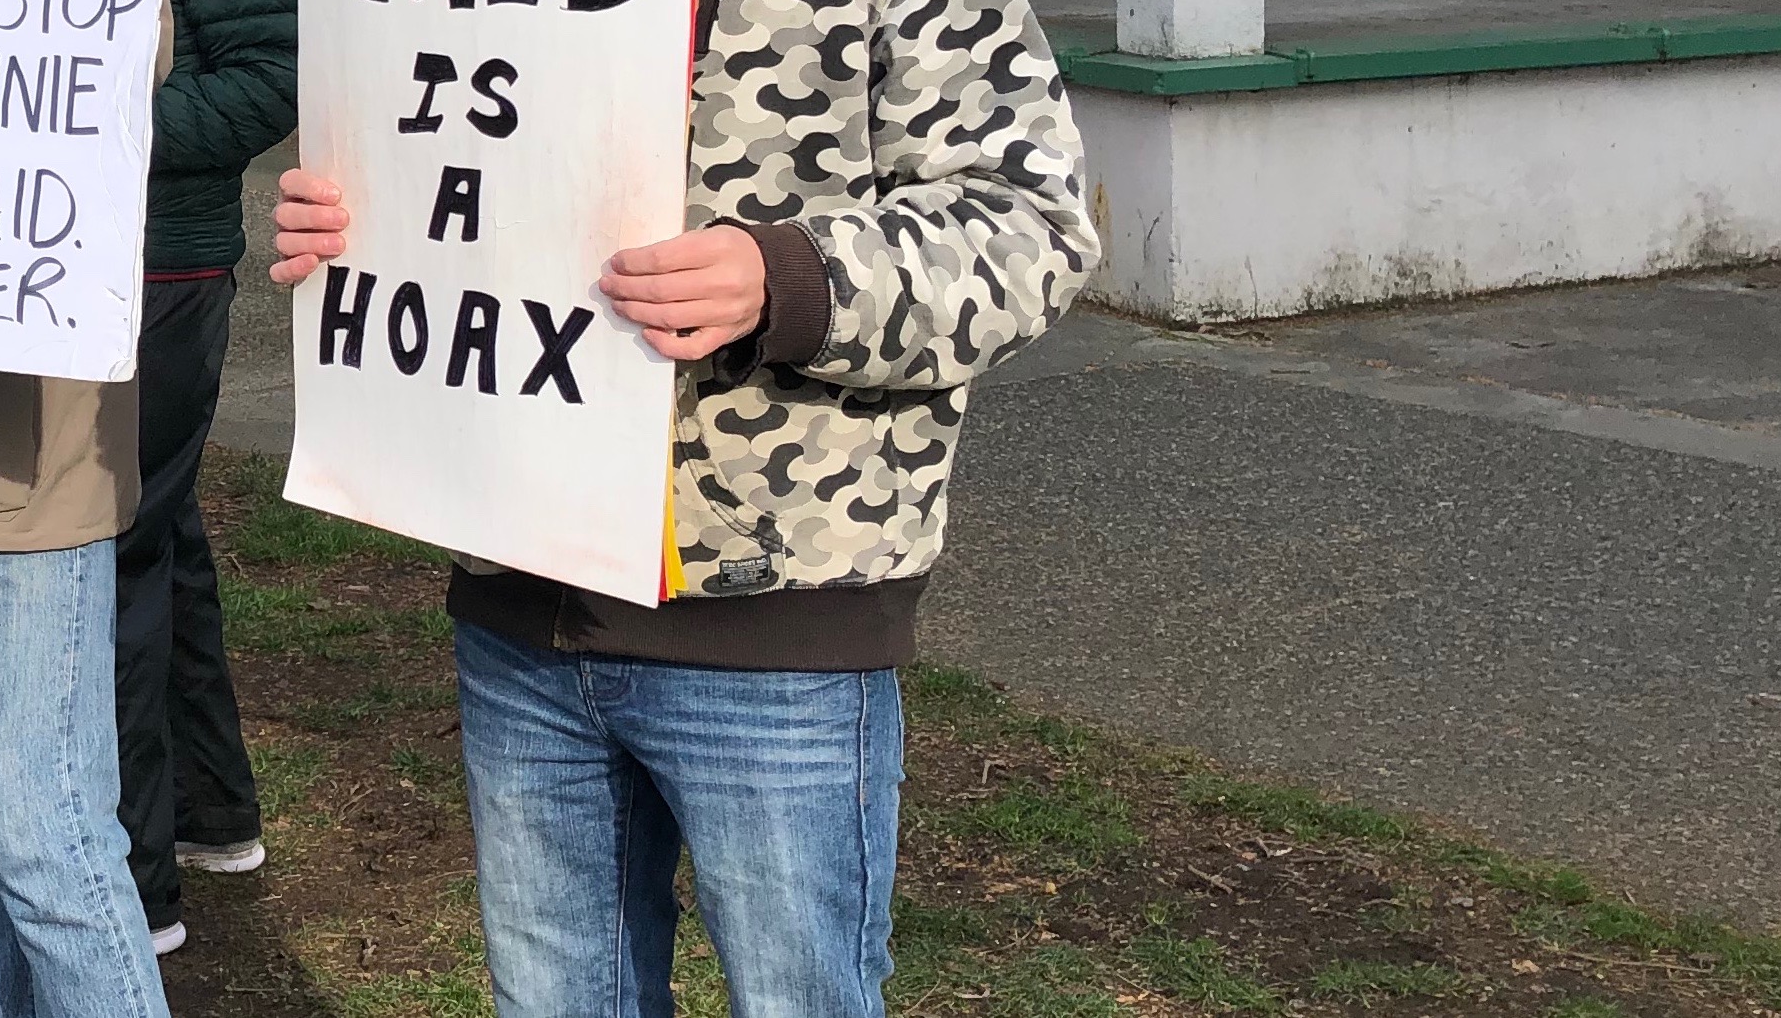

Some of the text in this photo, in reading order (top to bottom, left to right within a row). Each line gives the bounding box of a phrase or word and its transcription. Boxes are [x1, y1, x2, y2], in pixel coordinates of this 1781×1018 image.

[397, 52, 519, 139] IS
[427, 167, 482, 243] A
[319, 265, 596, 406] HOAX
